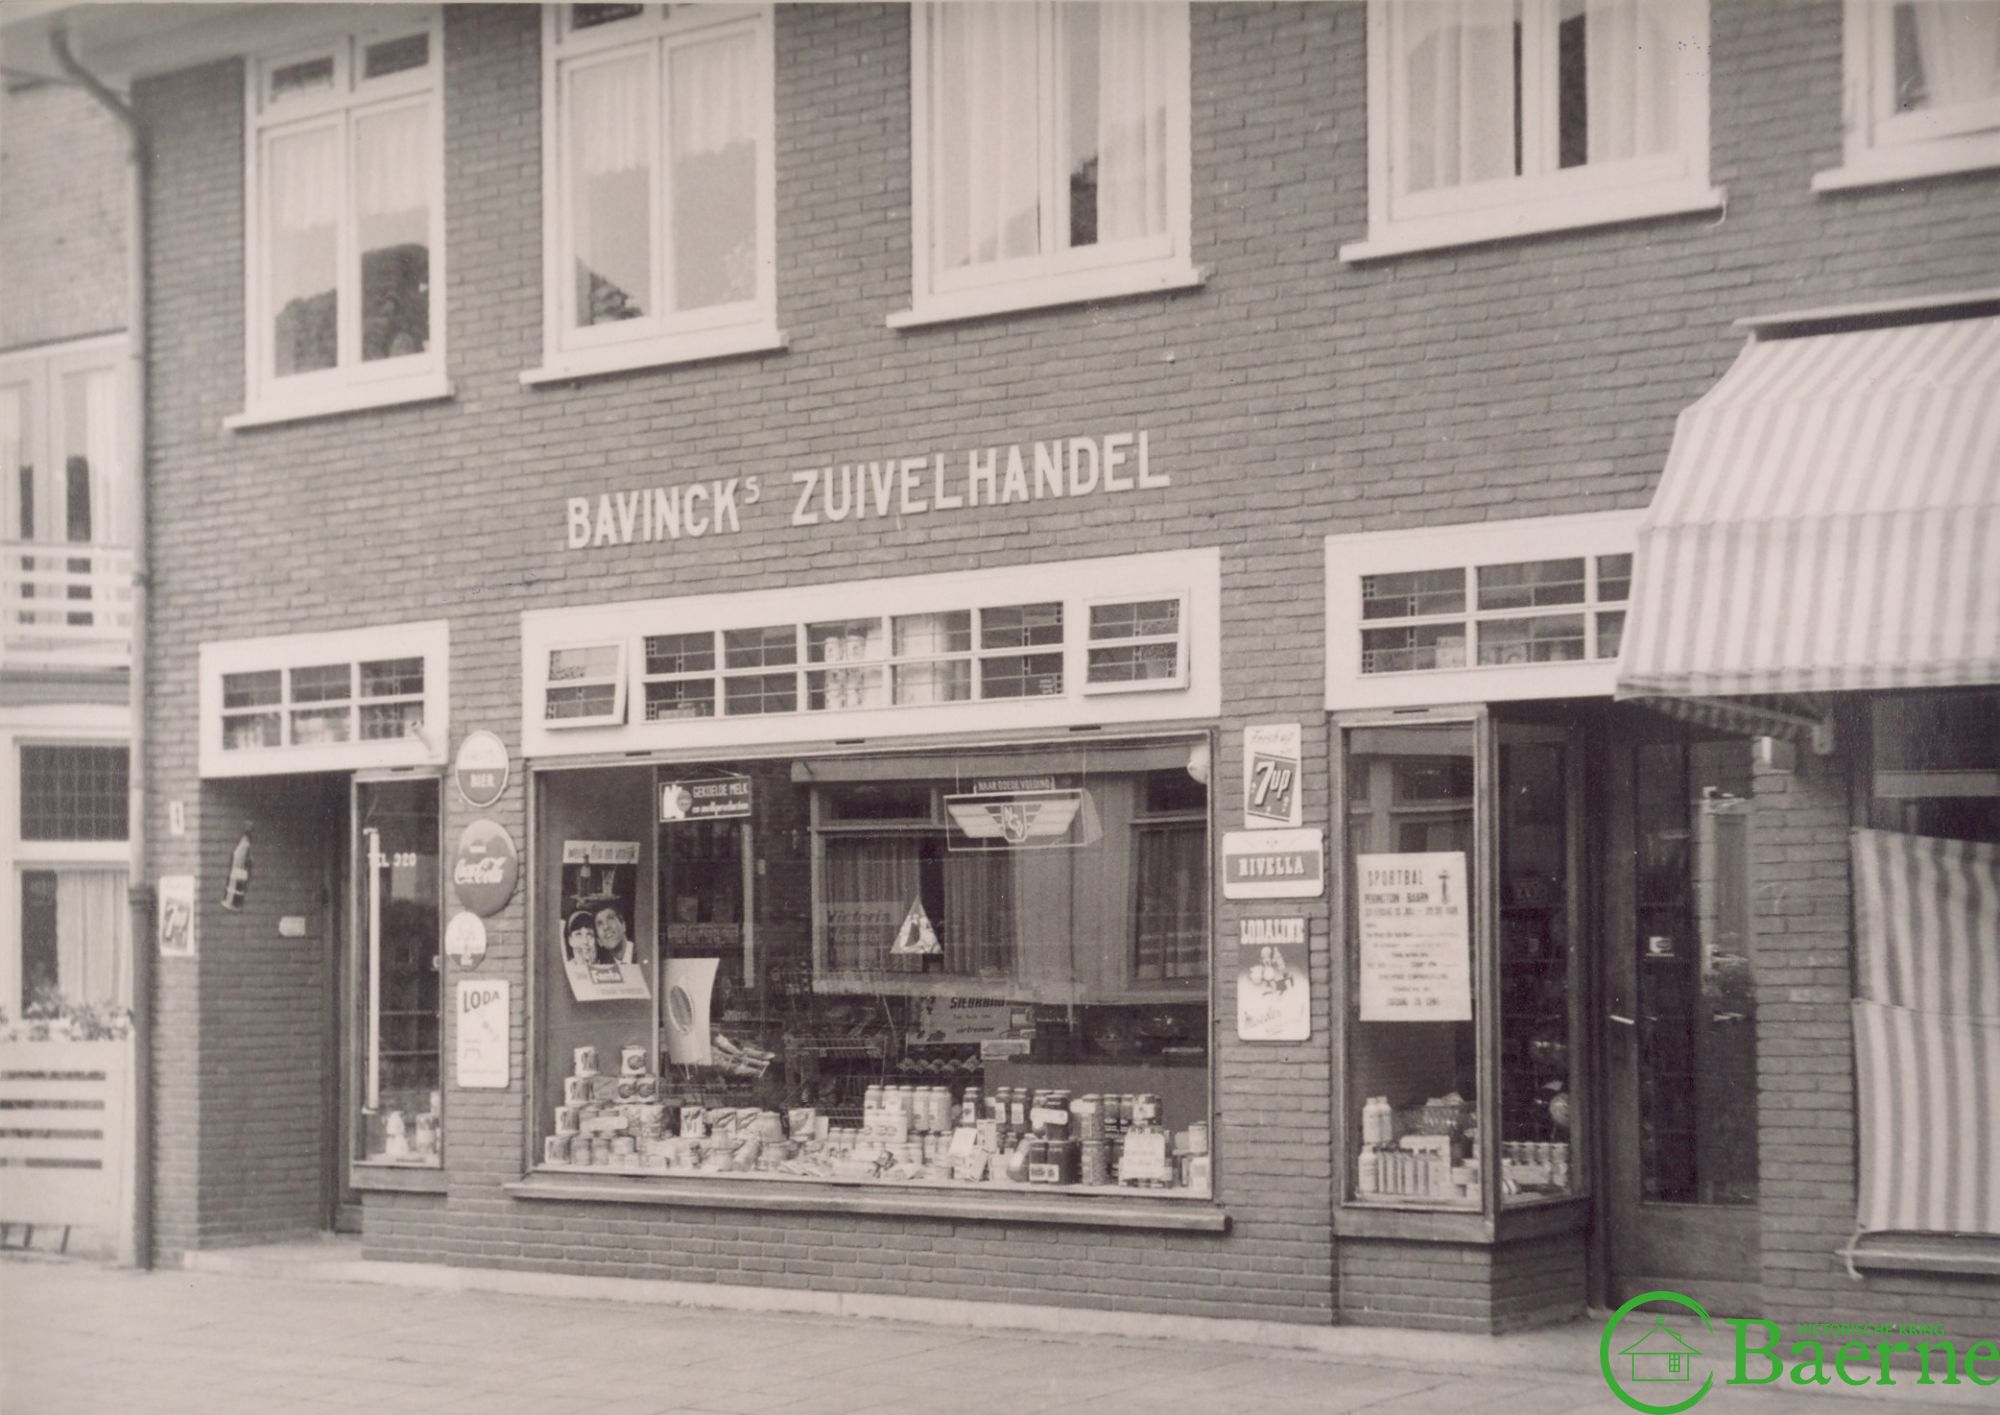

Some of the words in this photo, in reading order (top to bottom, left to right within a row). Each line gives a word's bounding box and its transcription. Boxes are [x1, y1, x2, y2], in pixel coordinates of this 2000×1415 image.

[791, 430, 1170, 526] ZUIVELHANDEL
[470, 773, 495, 788] BIER
[693, 784, 728, 799] GEKOELDE
[729, 782, 749, 796] MELK
[367, 852, 390, 868] TL
[454, 856, 507, 885] Coca-Cola
[1238, 856, 1305, 877] RIVELLA
[1367, 870, 1424, 887] SPORTBAL
[1239, 918, 1305, 945] LODALINE
[463, 990, 500, 1014] LODA
